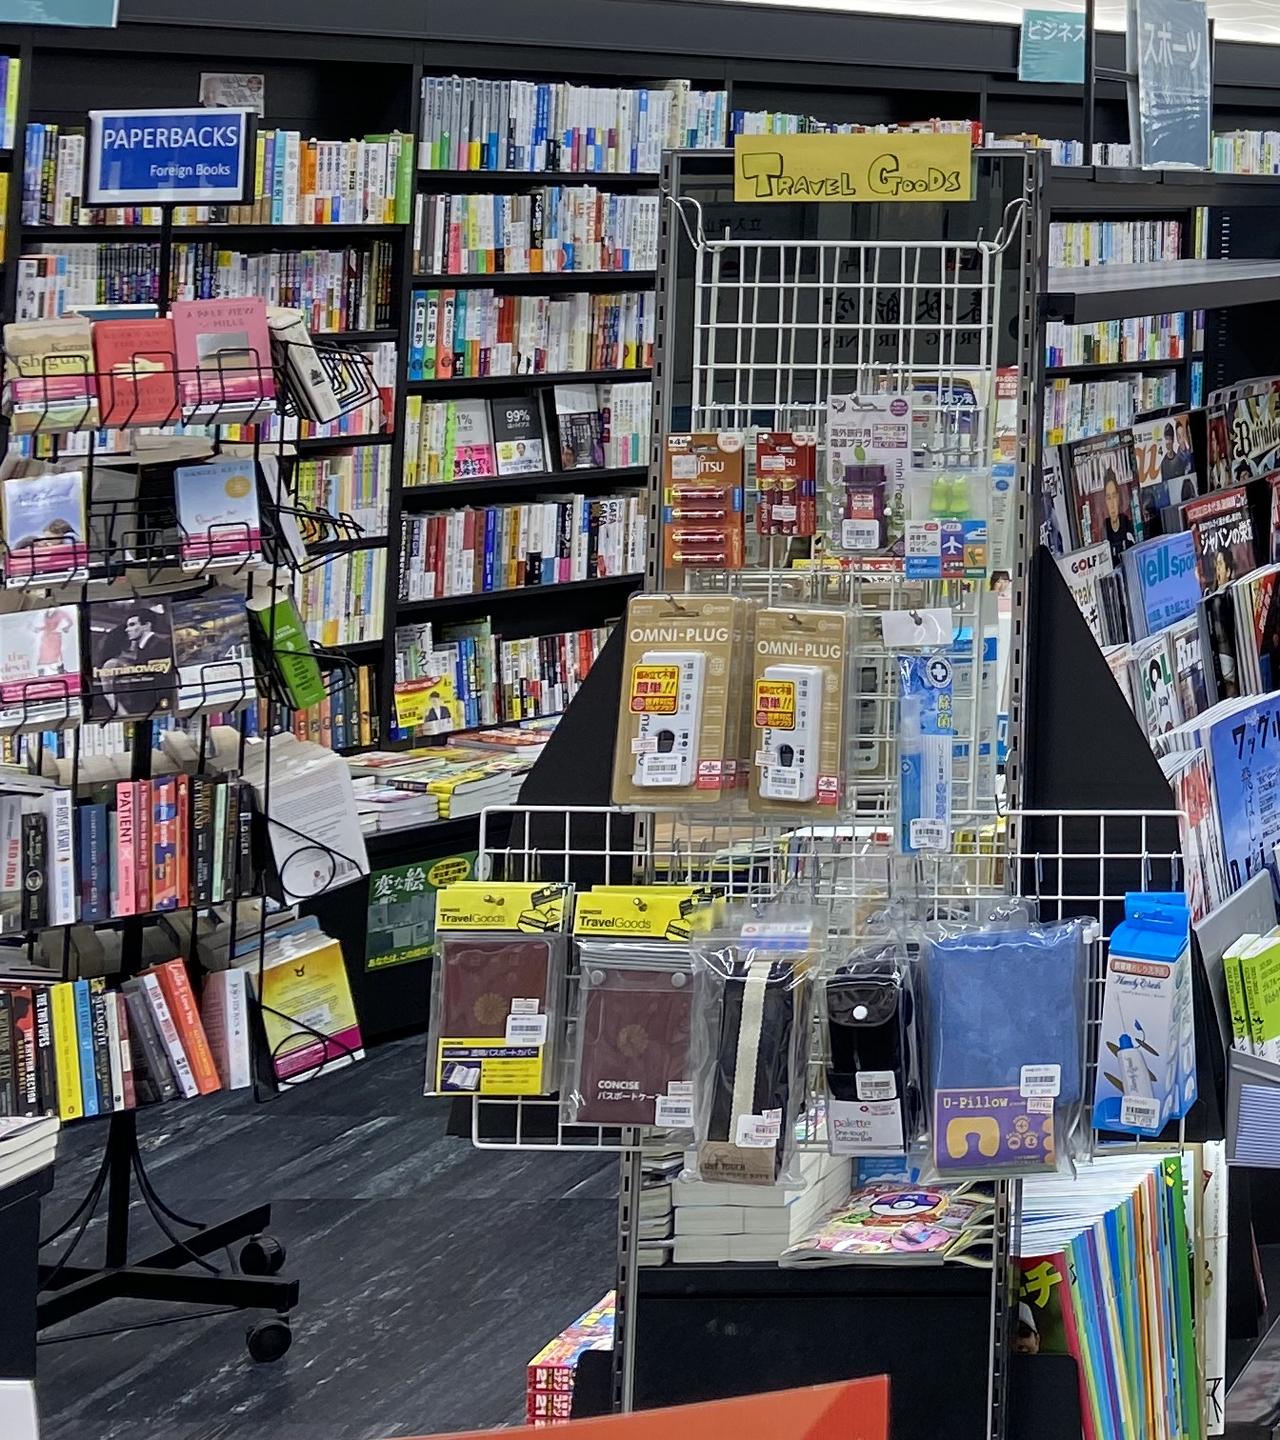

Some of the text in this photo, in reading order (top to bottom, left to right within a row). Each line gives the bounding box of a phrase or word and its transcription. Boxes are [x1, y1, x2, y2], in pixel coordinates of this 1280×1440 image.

[1027, 20, 1085, 41] ビジネス
[1143, 22, 1201, 70] スポーツ
[103, 125, 238, 150] PAPERBACKS
[150, 162, 230, 177] Foreign Books
[506, 410, 530, 422] 99%
[894, 458, 905, 481] mini
[1071, 554, 1097, 573] GOLF
[630, 627, 729, 643] OMNI-PLUG
[224, 645, 245, 660] 41
[756, 640, 842, 659] OMNI-PLUG
[92, 660, 172, 679] hemingway
[119, 791, 133, 845] PATIENT
[5, 839, 19, 888] RED JOAN
[374, 867, 426, 896] 変な絵
[36, 992, 50, 1047] THE TWO POPES
[26, 1073, 36, 1103] SECTION
[598, 1080, 640, 1090] CONCISE
[943, 1096, 1008, 1110] U-Pillow
[535, 1368, 547, 1389] 21
[535, 1394, 547, 1415] 21
